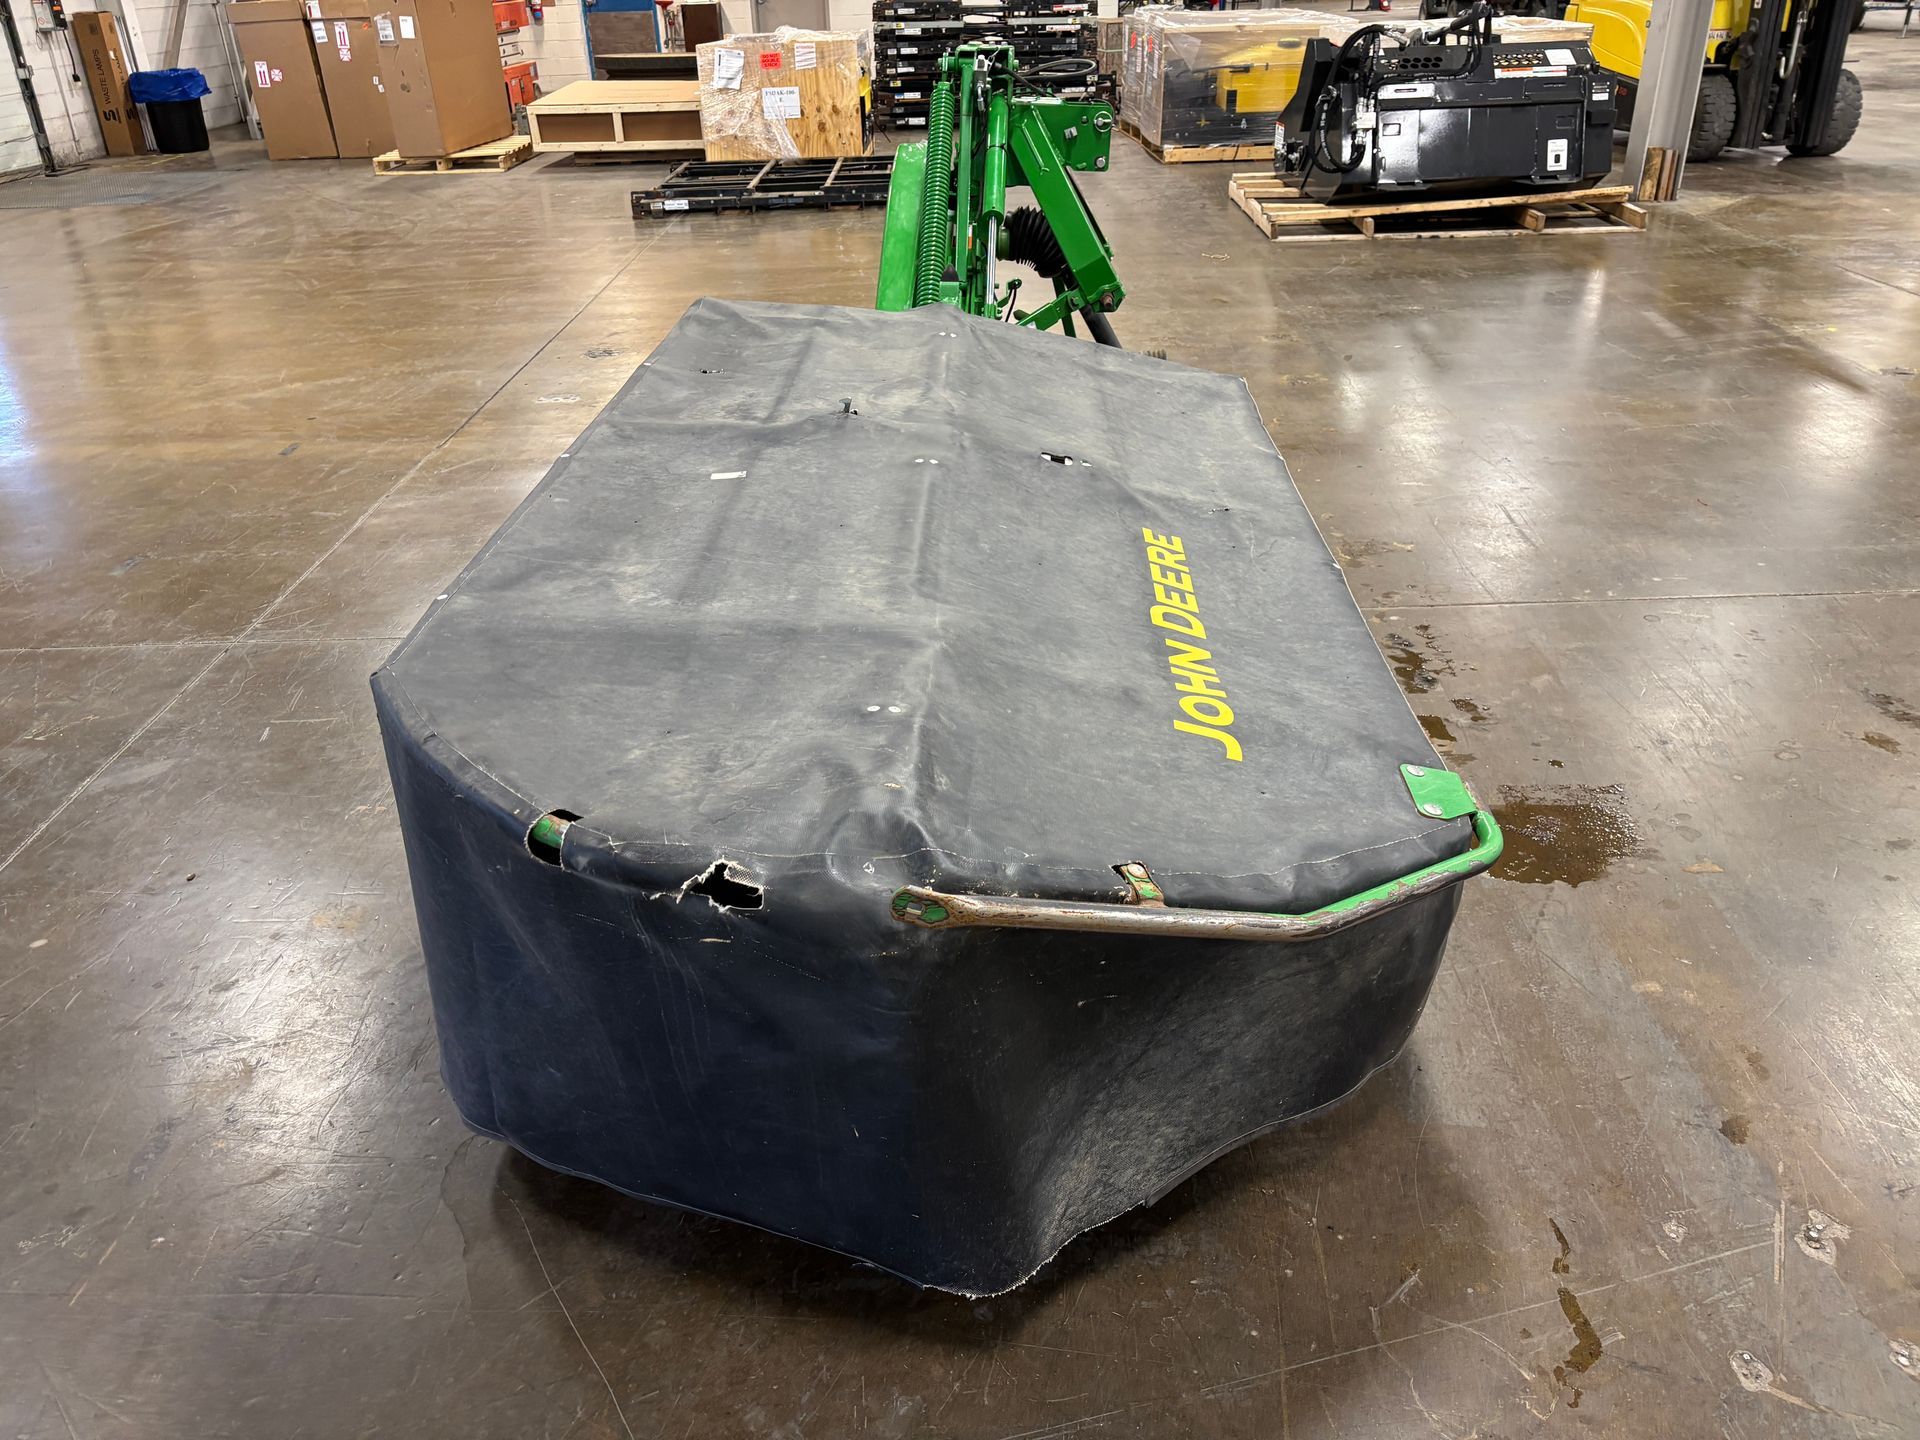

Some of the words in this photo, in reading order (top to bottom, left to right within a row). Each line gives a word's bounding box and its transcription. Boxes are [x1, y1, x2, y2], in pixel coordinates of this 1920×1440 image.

[92, 49, 104, 76] LAMPS
[99, 77, 111, 104] WASTE
[1142, 527, 1207, 639] DEERE
[1165, 637, 1243, 762] JOHN
